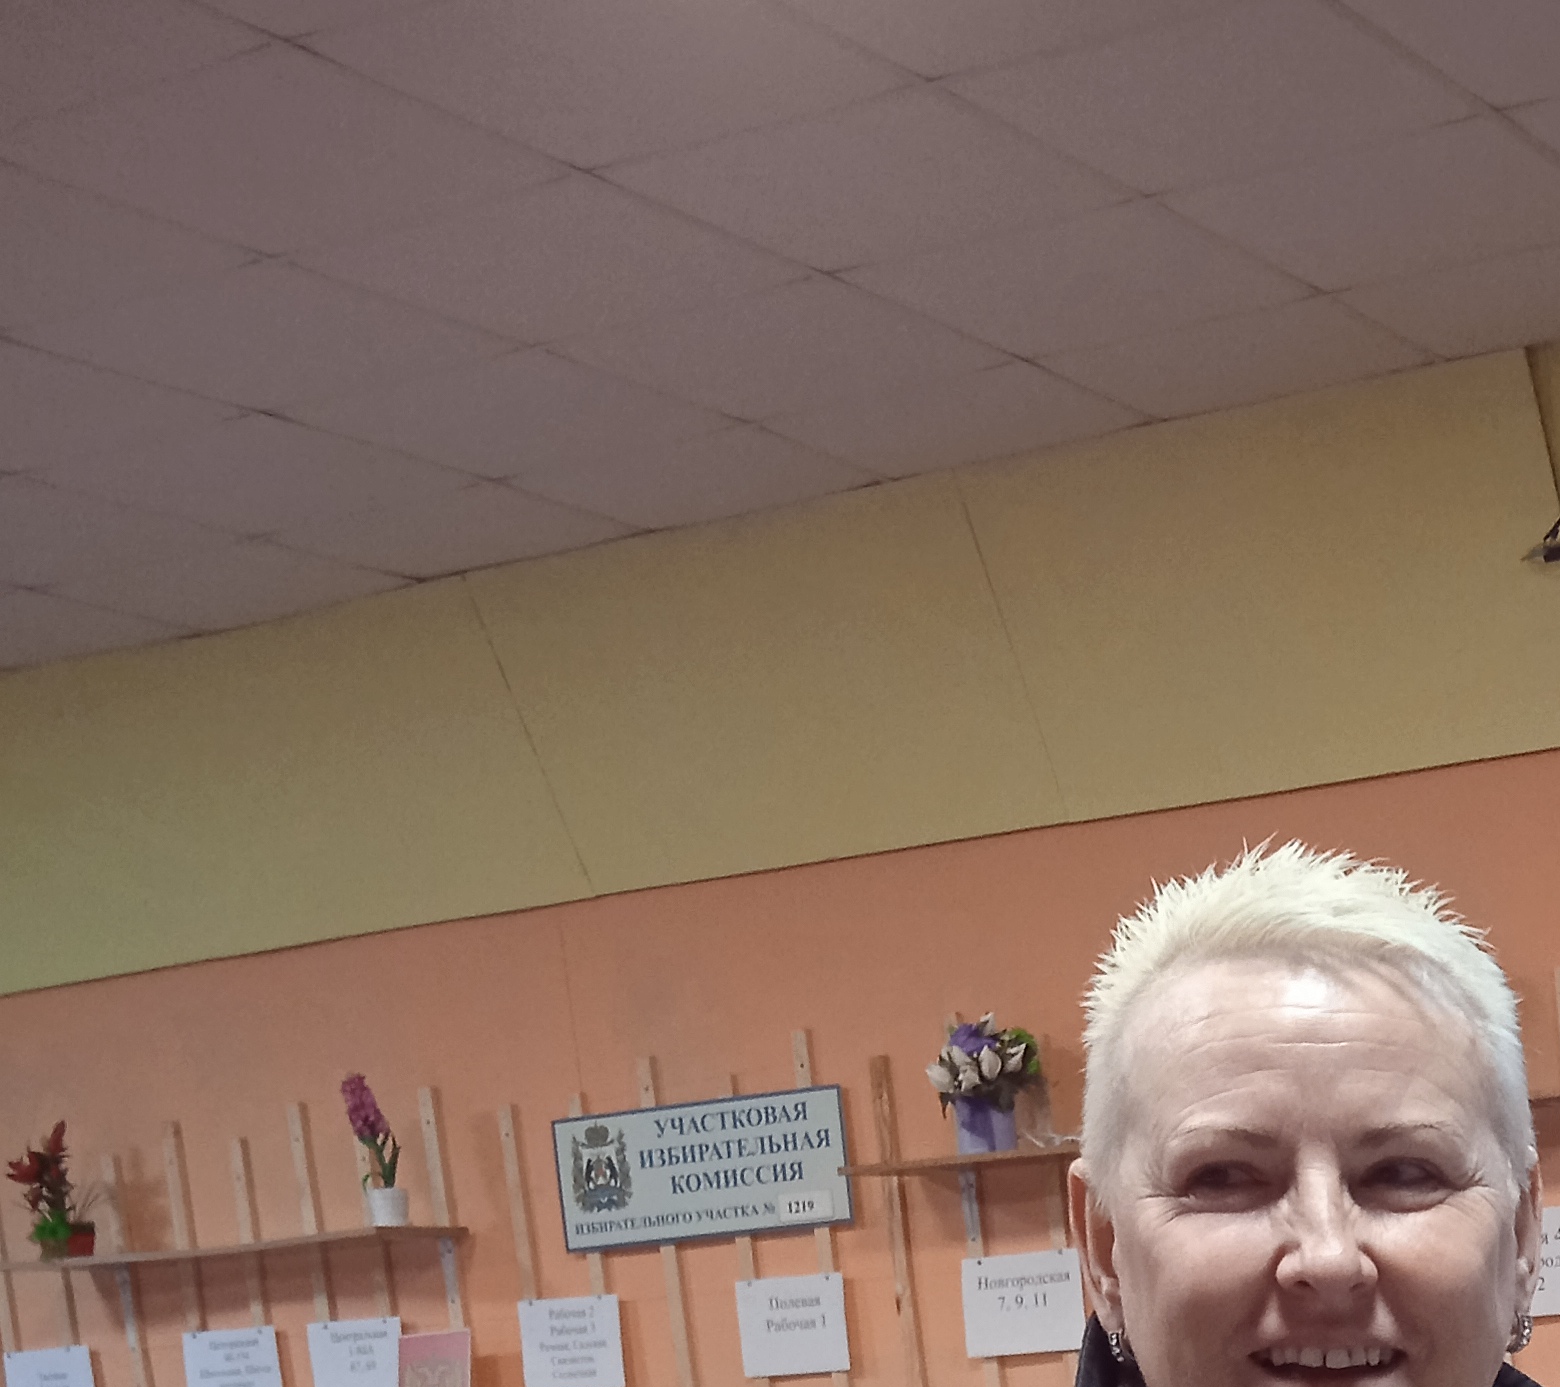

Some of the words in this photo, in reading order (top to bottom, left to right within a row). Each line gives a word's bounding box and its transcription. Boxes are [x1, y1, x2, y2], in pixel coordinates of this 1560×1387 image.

[653, 1101, 808, 1138] УЧАСТКОВАЯ
[639, 1128, 831, 1169] ИЗБИРАТЕЛЬНАЯ
[670, 1161, 804, 1194] КОМИССИЯ
[575, 1212, 693, 1235] ИЗБИРАТЕЛЬНОГО
[695, 1206, 759, 1224] УЧАСТКА
[787, 1200, 815, 1215] 1219
[977, 1271, 1071, 1291] Новгородская
[769, 1297, 821, 1311] Полевая
[1034, 1292, 1048, 1307] 11
[766, 1318, 817, 1332] Рабочая
